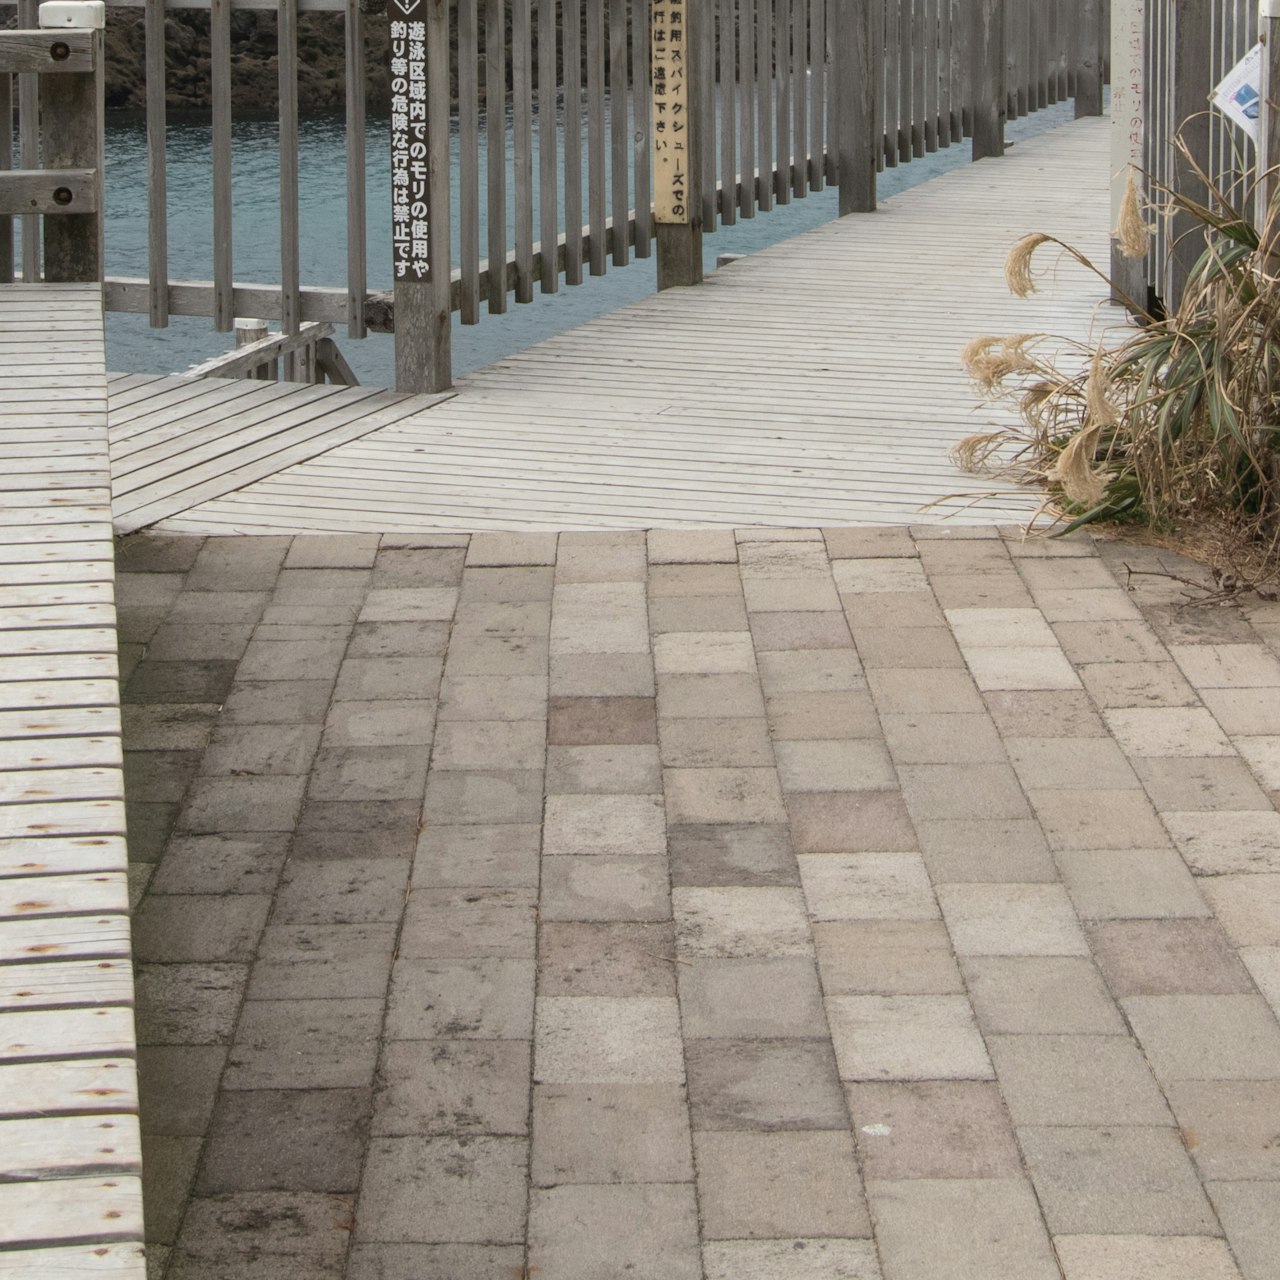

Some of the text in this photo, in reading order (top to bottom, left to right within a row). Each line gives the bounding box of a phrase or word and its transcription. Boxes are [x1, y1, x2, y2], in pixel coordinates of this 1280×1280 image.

[390, 21, 410, 277] 釣り等の危険な行為は禁止です
[408, 21, 429, 278] 遊泳区域内でのモリの使用や
